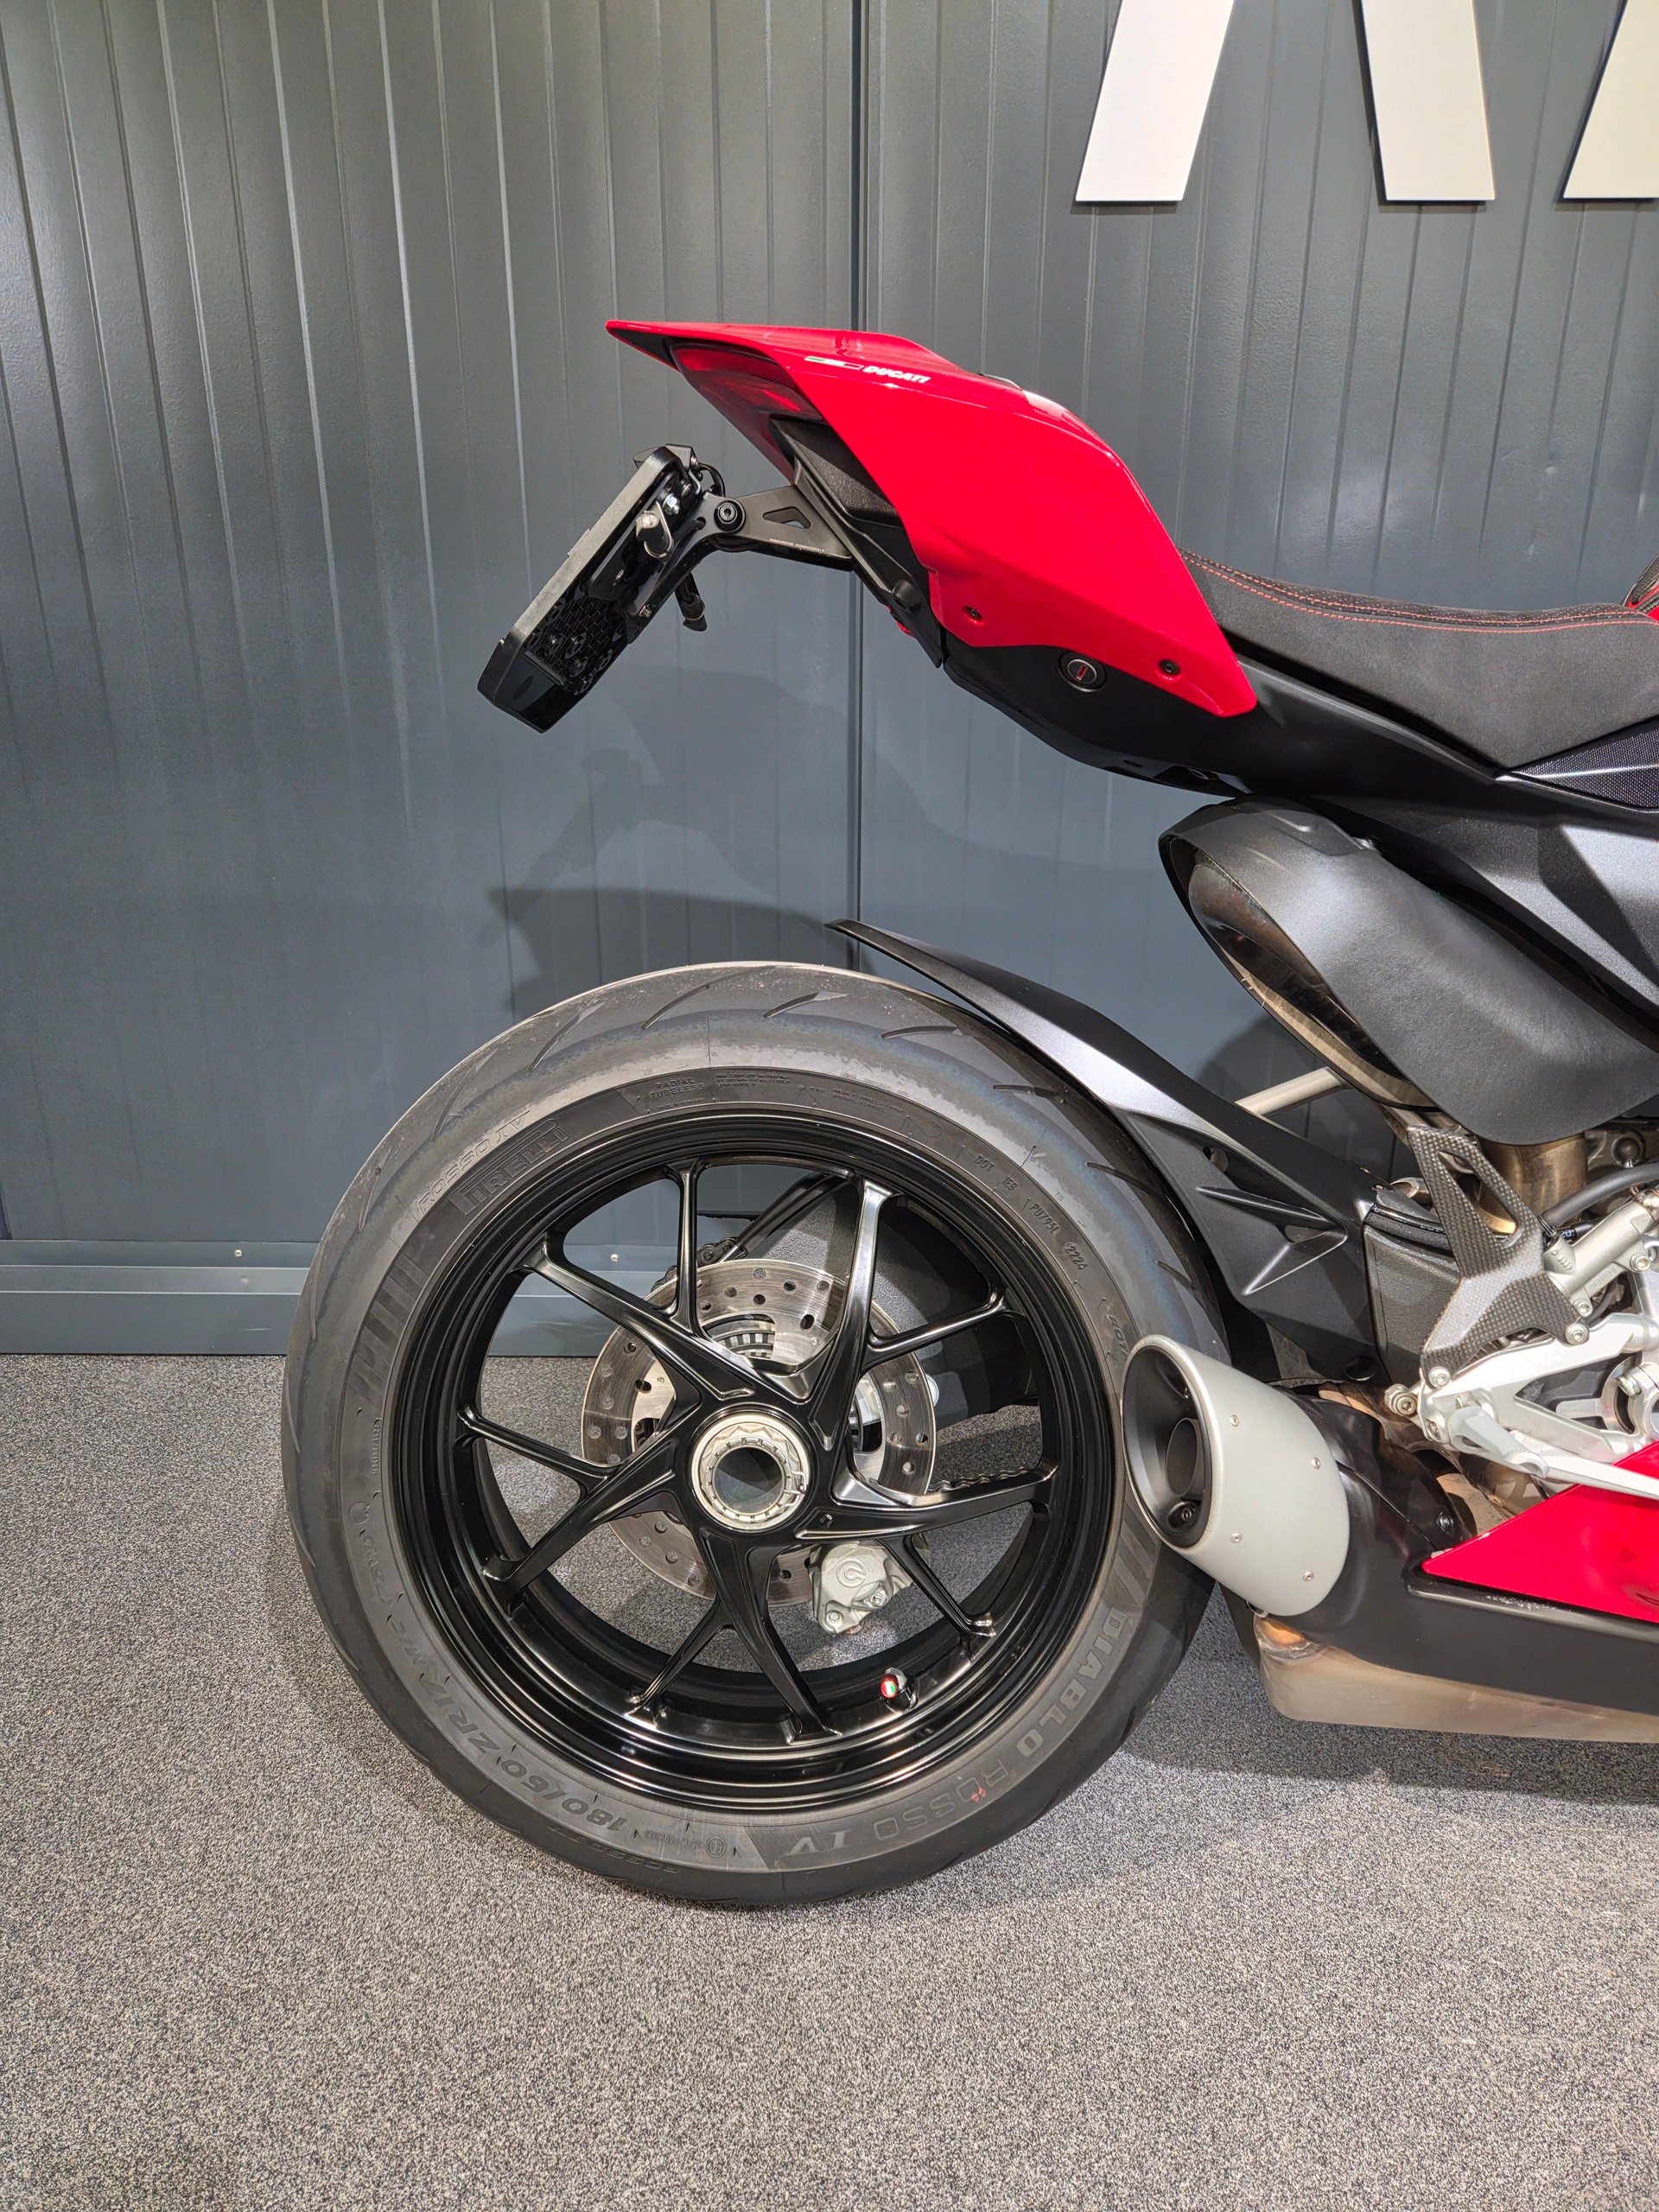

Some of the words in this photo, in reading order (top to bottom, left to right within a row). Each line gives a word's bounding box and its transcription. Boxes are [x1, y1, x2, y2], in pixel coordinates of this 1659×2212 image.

[862, 365, 931, 384] DUCATI
[650, 1083, 705, 1099] TUBELESS
[654, 1077, 695, 1090] RADIAL
[414, 1136, 493, 1214] ROSSO
[490, 1109, 535, 1143] IV
[445, 1115, 569, 1217] PIRELLI
[975, 1154, 995, 1172] DOT
[1065, 1244, 1088, 1270] 2224
[1016, 1606, 1128, 1758] DIABLO
[499, 1758, 626, 1833] 180/60
[873, 1759, 1009, 1841] ROSSO
[784, 1828, 854, 1857] IV
